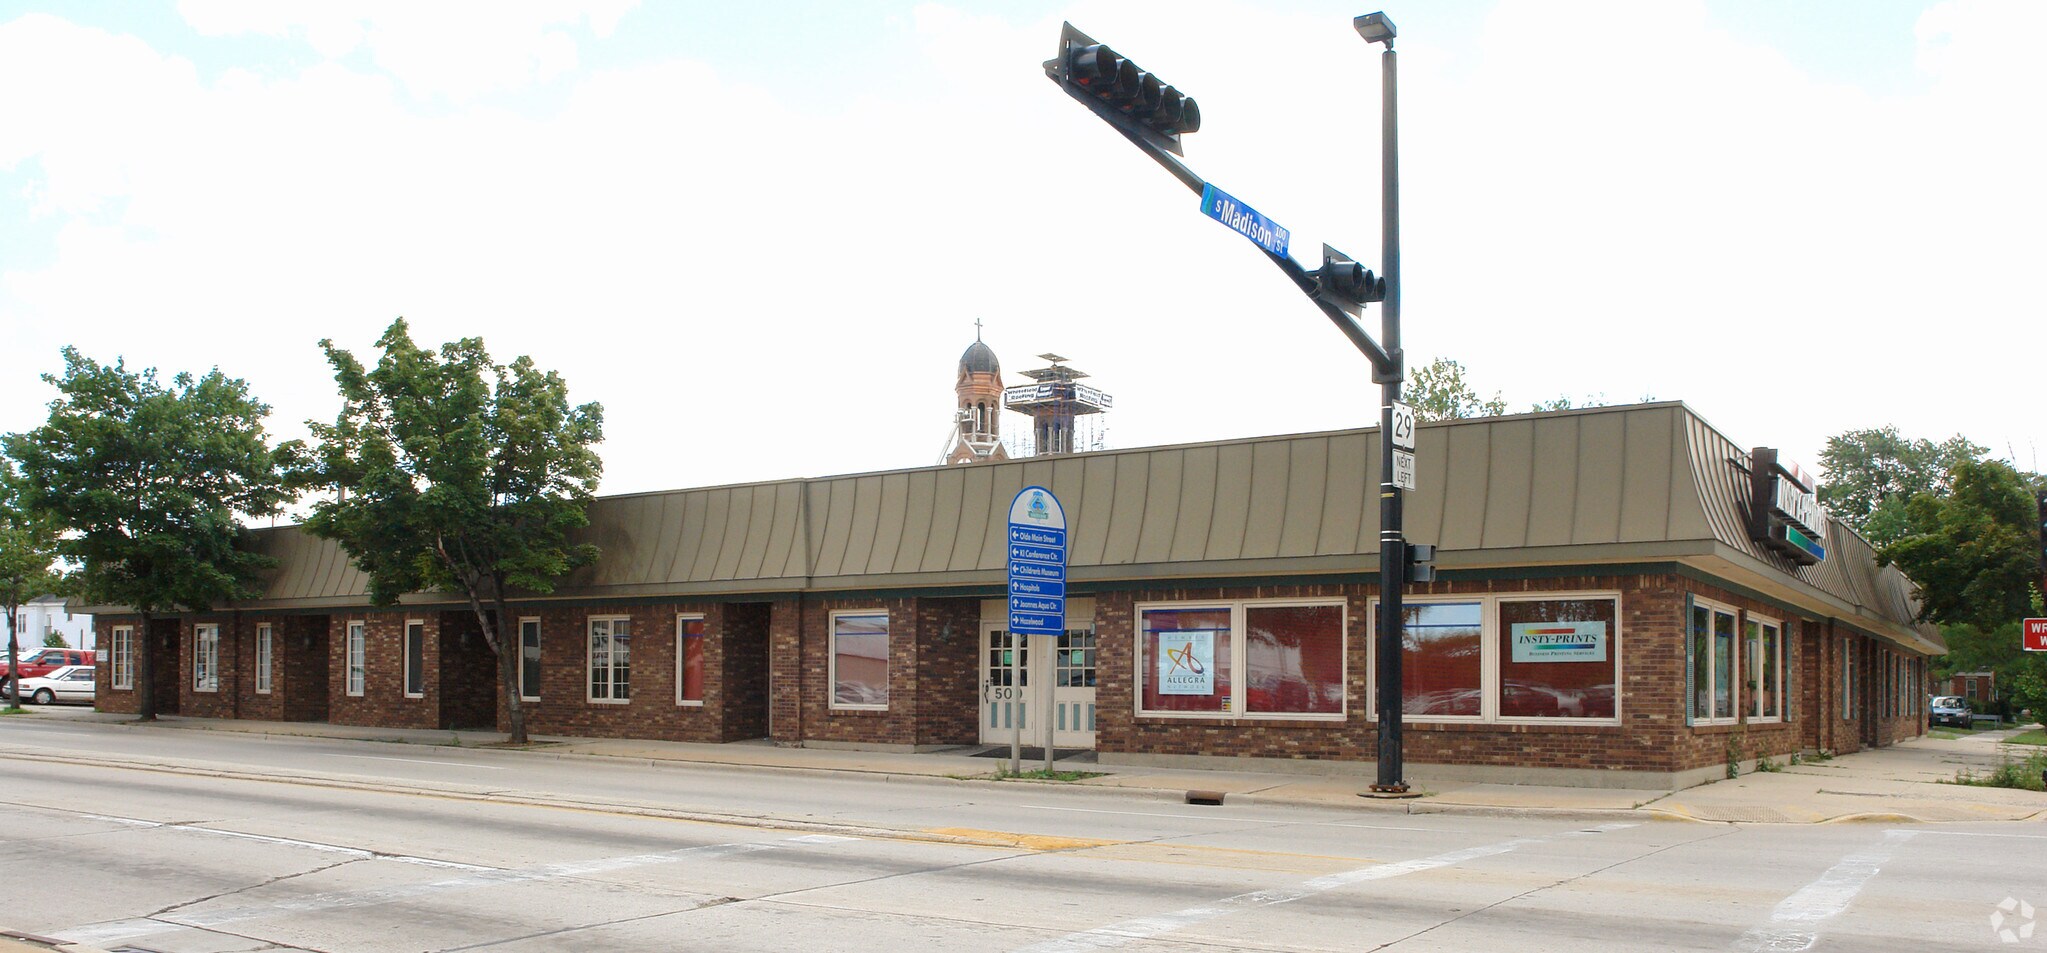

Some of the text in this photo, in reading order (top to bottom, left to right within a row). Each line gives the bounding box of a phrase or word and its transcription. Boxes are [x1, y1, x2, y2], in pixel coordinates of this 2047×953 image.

[1215, 199, 1272, 247] S Madison
[1395, 411, 1412, 440] 29
[1396, 455, 1411, 470] NEXT
[1397, 471, 1411, 485] LEFT
[1031, 533, 1043, 542] Main
[1043, 534, 1056, 544] Street
[1025, 549, 1050, 560] Conference
[1041, 567, 1060, 577] Museum
[1019, 583, 1040, 593] Hospitals
[1037, 601, 1050, 610] Aqua
[1519, 634, 1597, 644] INSTY-PRINTS
[1167, 676, 1205, 684] ALLEGRA
